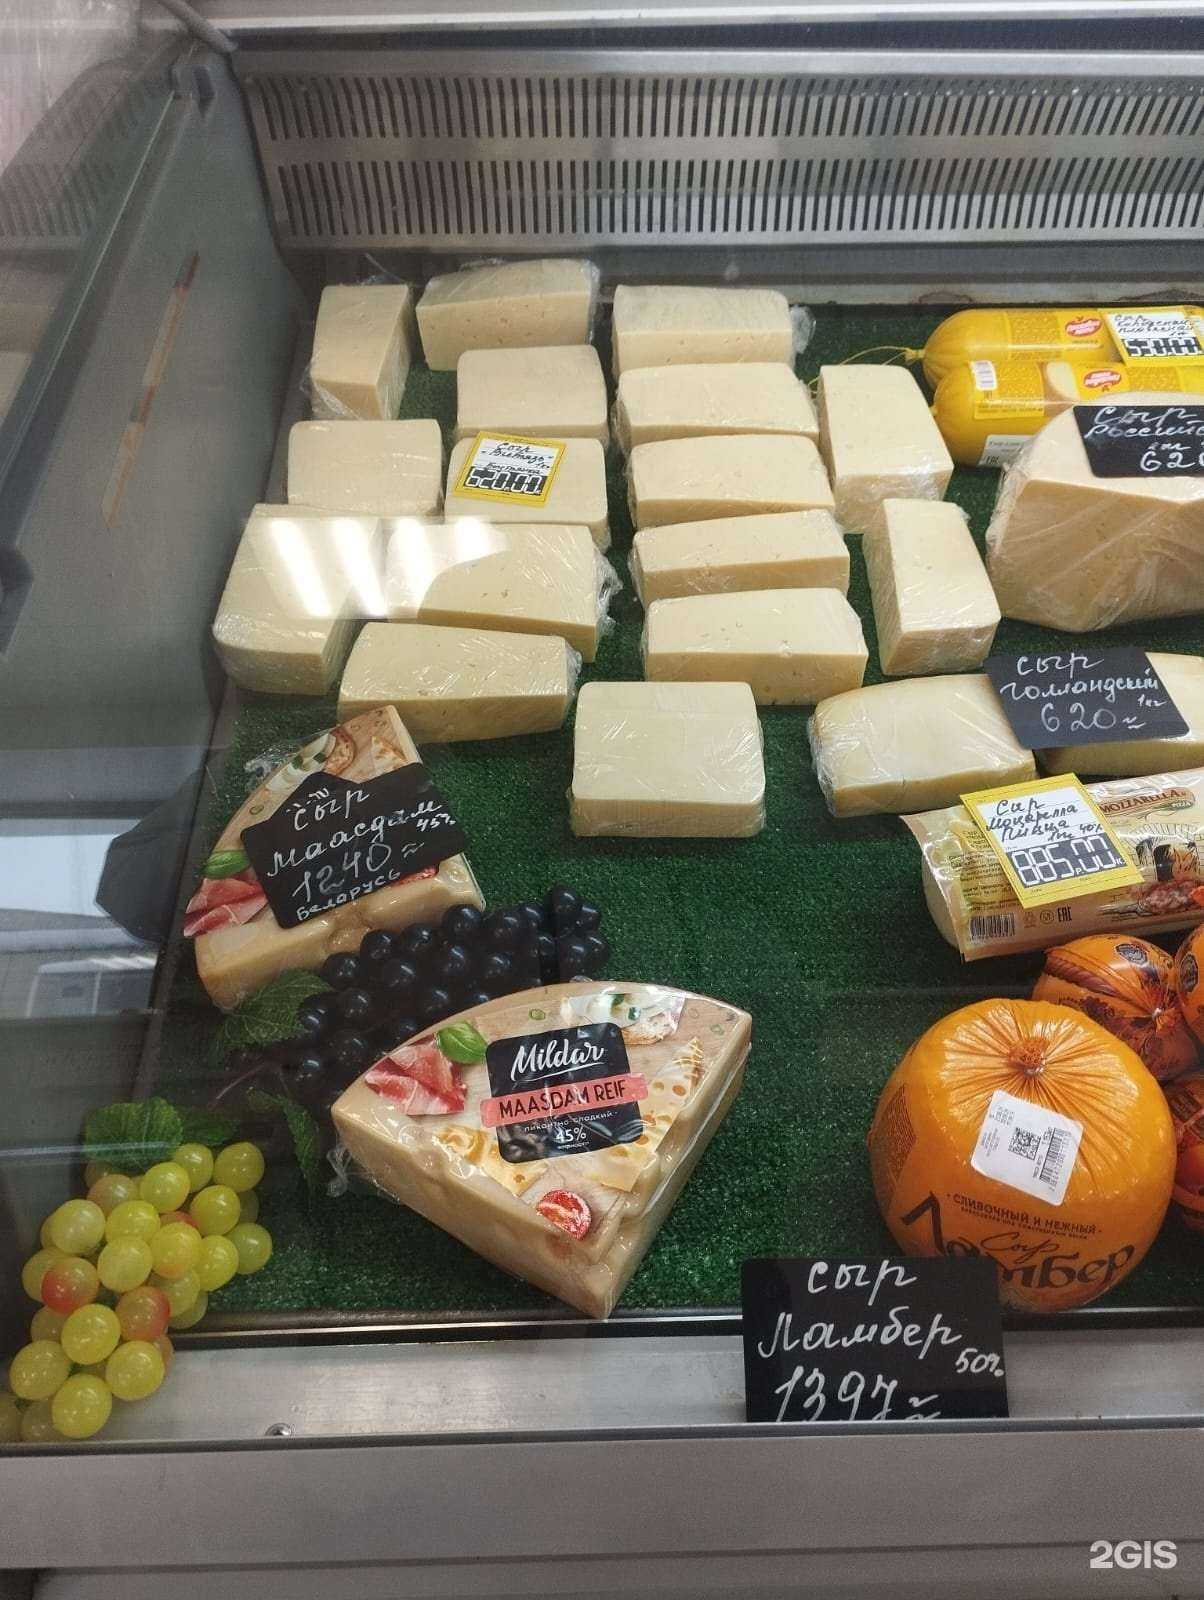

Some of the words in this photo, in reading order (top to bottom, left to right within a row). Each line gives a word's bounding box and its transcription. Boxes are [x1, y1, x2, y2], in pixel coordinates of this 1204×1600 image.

[1041, 702, 1116, 732] 620
[292, 842, 391, 902] 1240
[296, 869, 401, 921] Беларусь
[510, 1039, 604, 1082] Mildar
[499, 1084, 589, 1119] MAASDAM
[594, 1079, 626, 1102] REIF
[555, 1123, 587, 1142] 45%
[953, 1193, 1029, 1223] СЛИВОЧНЫЙ
[1033, 1217, 1042, 1227] И
[1045, 1219, 1096, 1235] НЕЖНЫЙ
[980, 1232, 1060, 1264] Сыр
[758, 1306, 962, 1359] Ламбер
